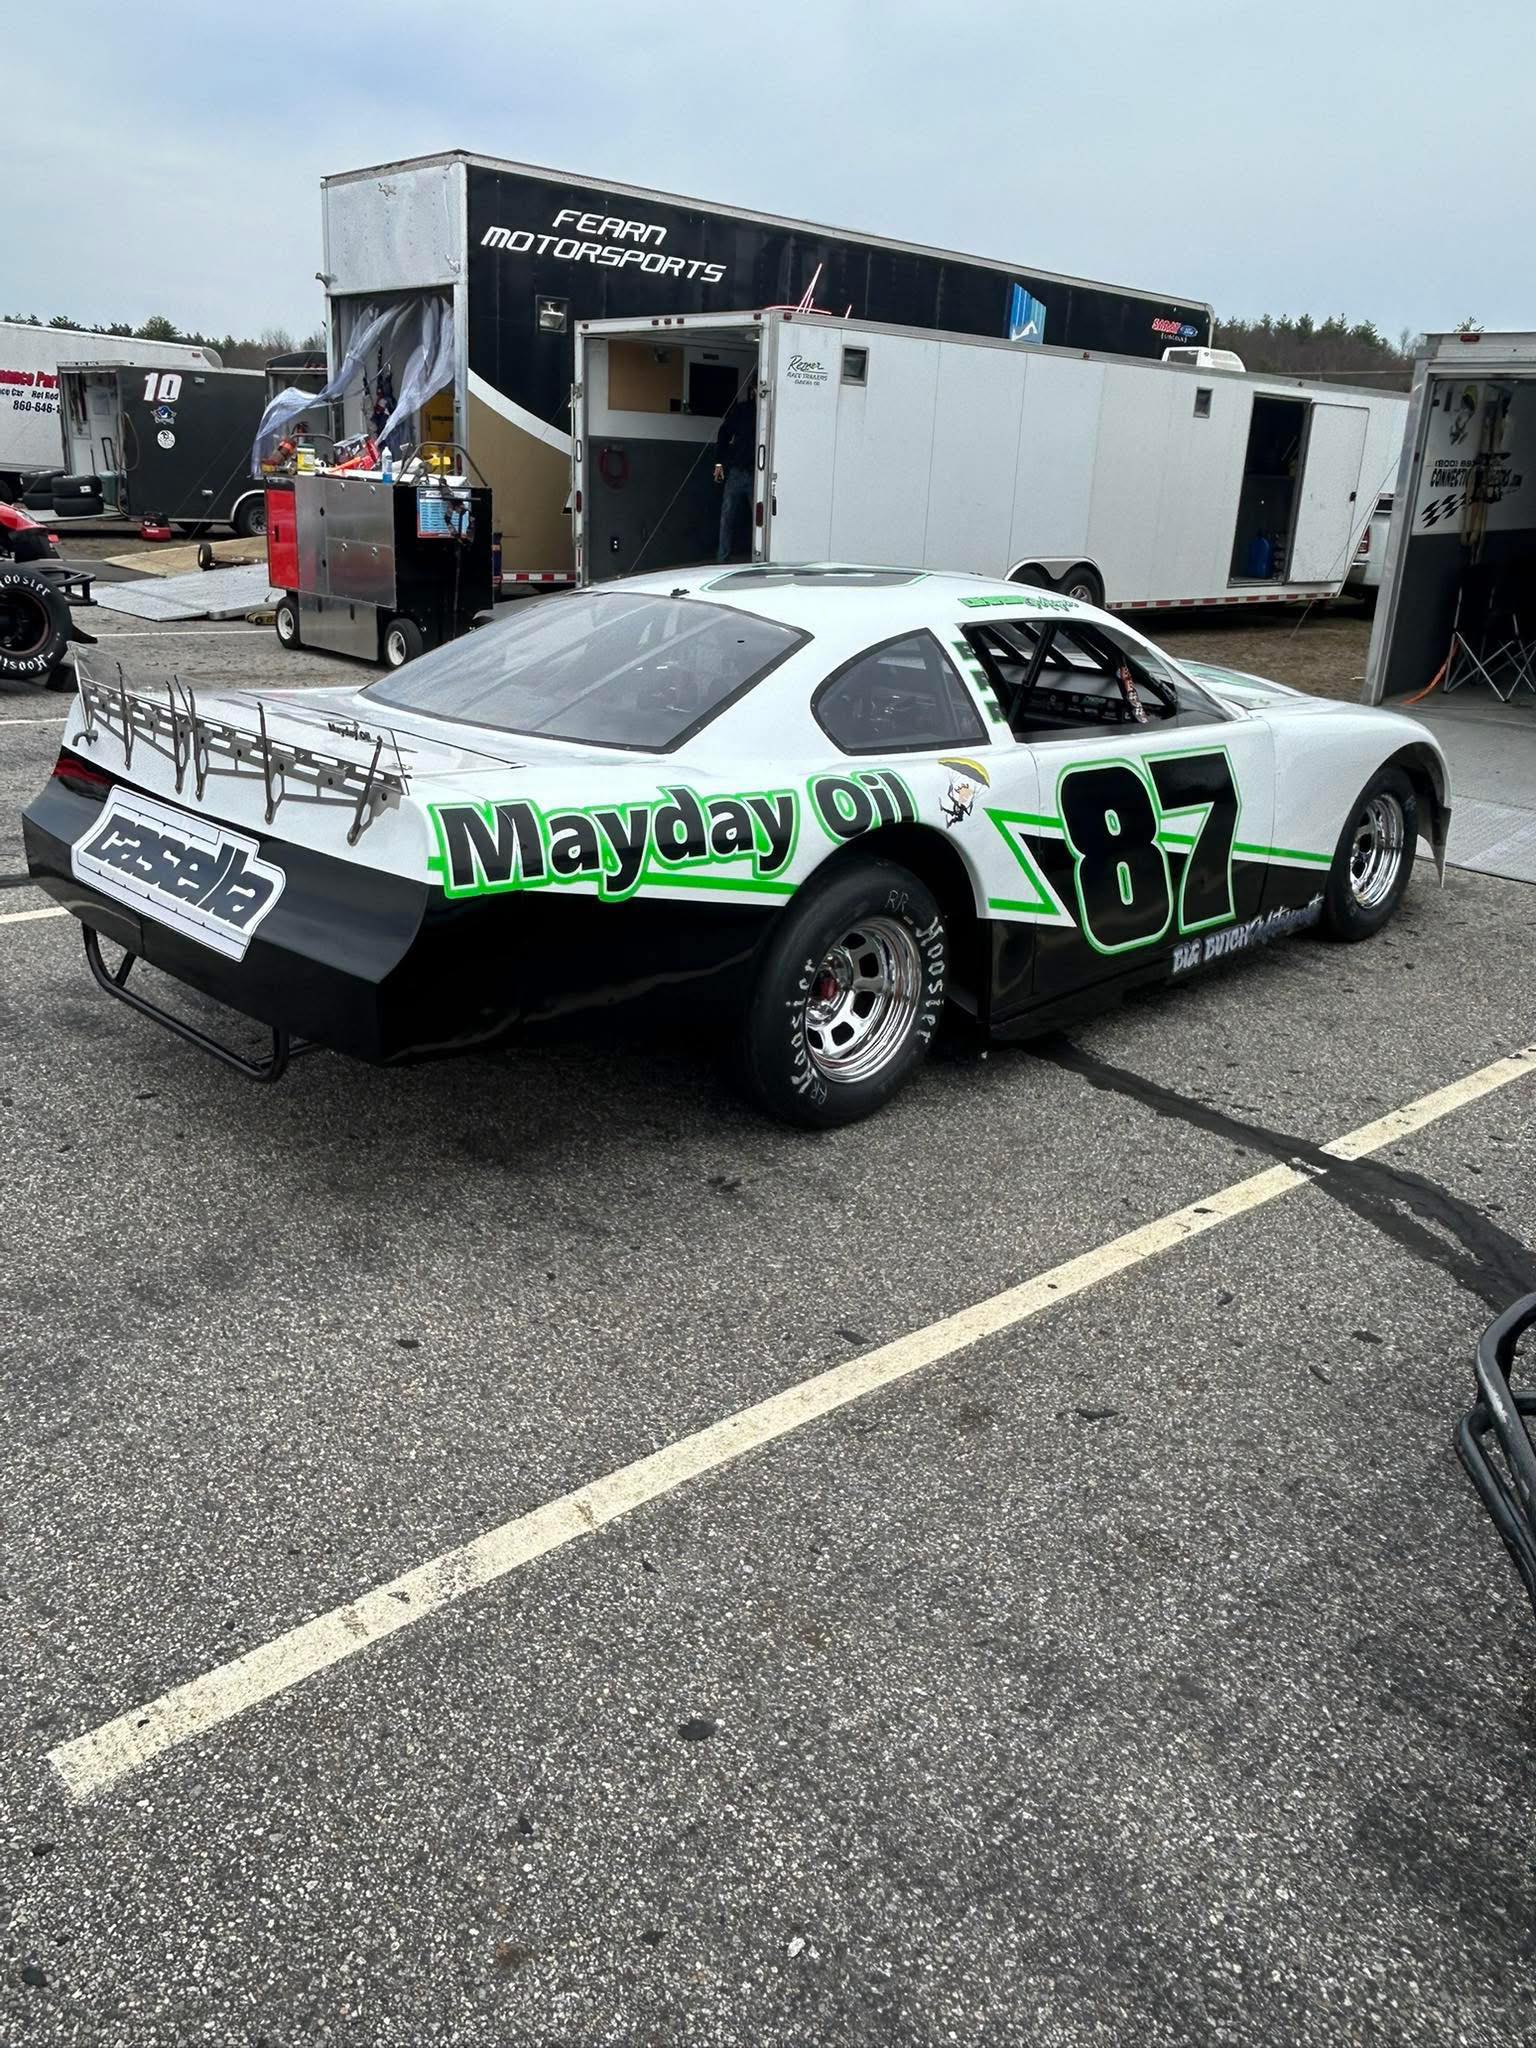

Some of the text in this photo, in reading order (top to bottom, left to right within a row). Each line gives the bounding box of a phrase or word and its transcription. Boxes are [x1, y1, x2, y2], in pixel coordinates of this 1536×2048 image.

[480, 226, 727, 283] MOTORSPORTS
[552, 209, 667, 245] FEARN
[143, 372, 182, 403] 10
[84, 814, 275, 930] casella
[431, 771, 915, 896] Mayday Oil
[1058, 747, 1241, 952] 87
[915, 916, 947, 1043] Hoosier
[1173, 924, 1251, 976] BIG BUTCH
[785, 959, 819, 1093] Hoosier
